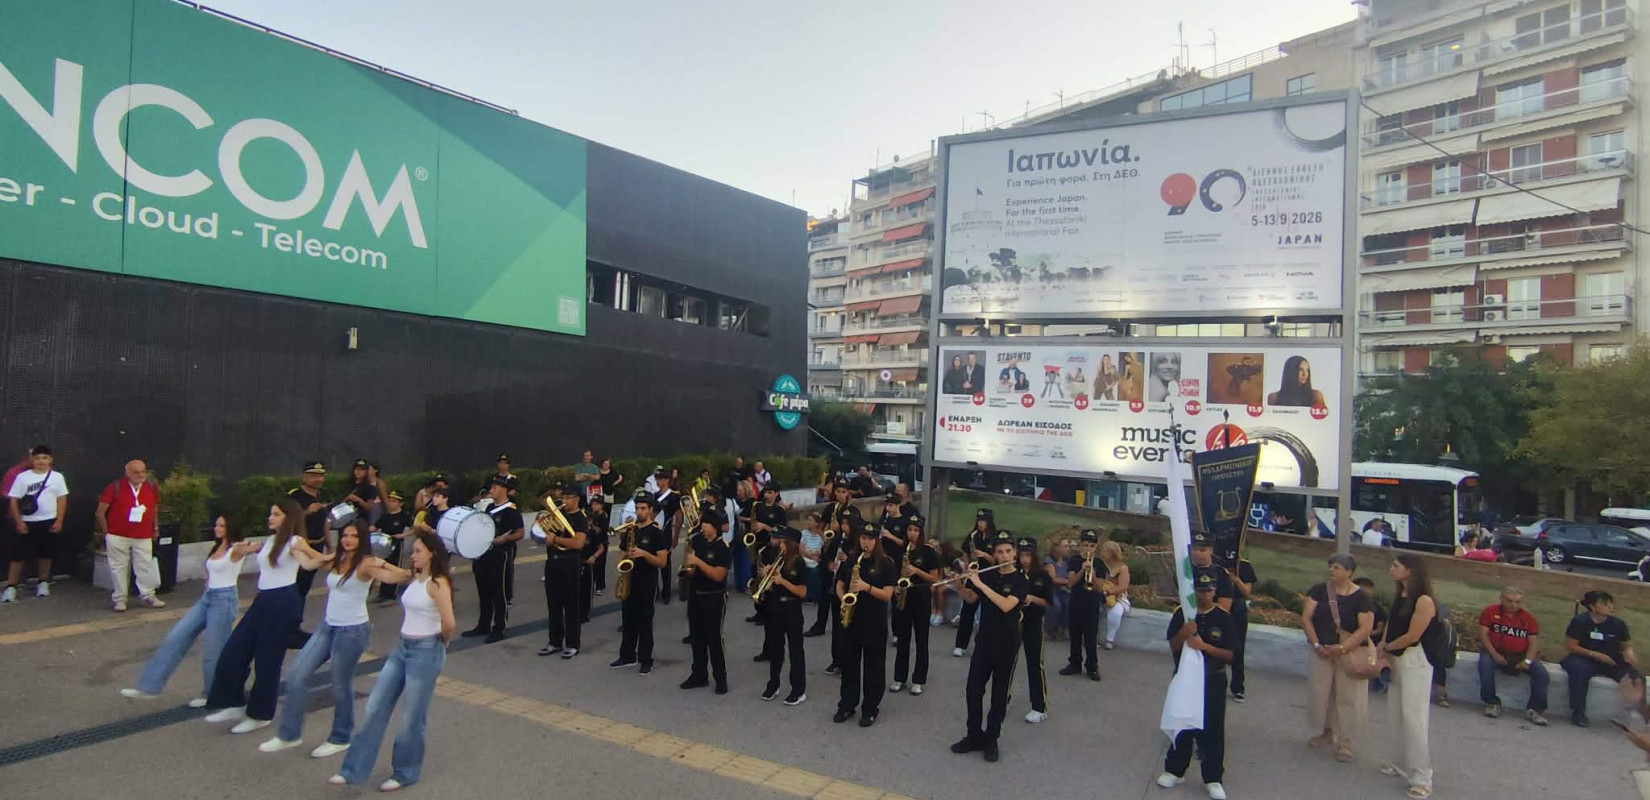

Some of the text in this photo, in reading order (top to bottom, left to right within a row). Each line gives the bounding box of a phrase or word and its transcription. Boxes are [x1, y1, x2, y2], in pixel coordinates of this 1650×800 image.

[1007, 139, 1141, 173] Ιαπωνία.
[1006, 168, 1141, 188] Για πρώτη φορά. Στη ΔΕΘ.
[1006, 197, 1055, 207] Experience
[1005, 208, 1020, 217] For
[1022, 207, 1037, 215] the
[1039, 206, 1056, 215] first
[1005, 215, 1087, 227] At the Thessaloniki
[92, 190, 219, 240] Cloud
[253, 222, 388, 271] Telecom
[1277, 233, 1323, 246] JAPAN
[997, 351, 1031, 362] STAVENTO
[948, 415, 982, 423] ΕΝΑΡΞΗ
[997, 419, 1073, 430] ΔΩΡΕΑΝ ΕΙΣΟΔΟΣ
[947, 424, 972, 432] 21.30
[1121, 423, 1197, 444] music
[27, 480, 44, 493] NIK
[1493, 624, 1528, 638] SPAIN
